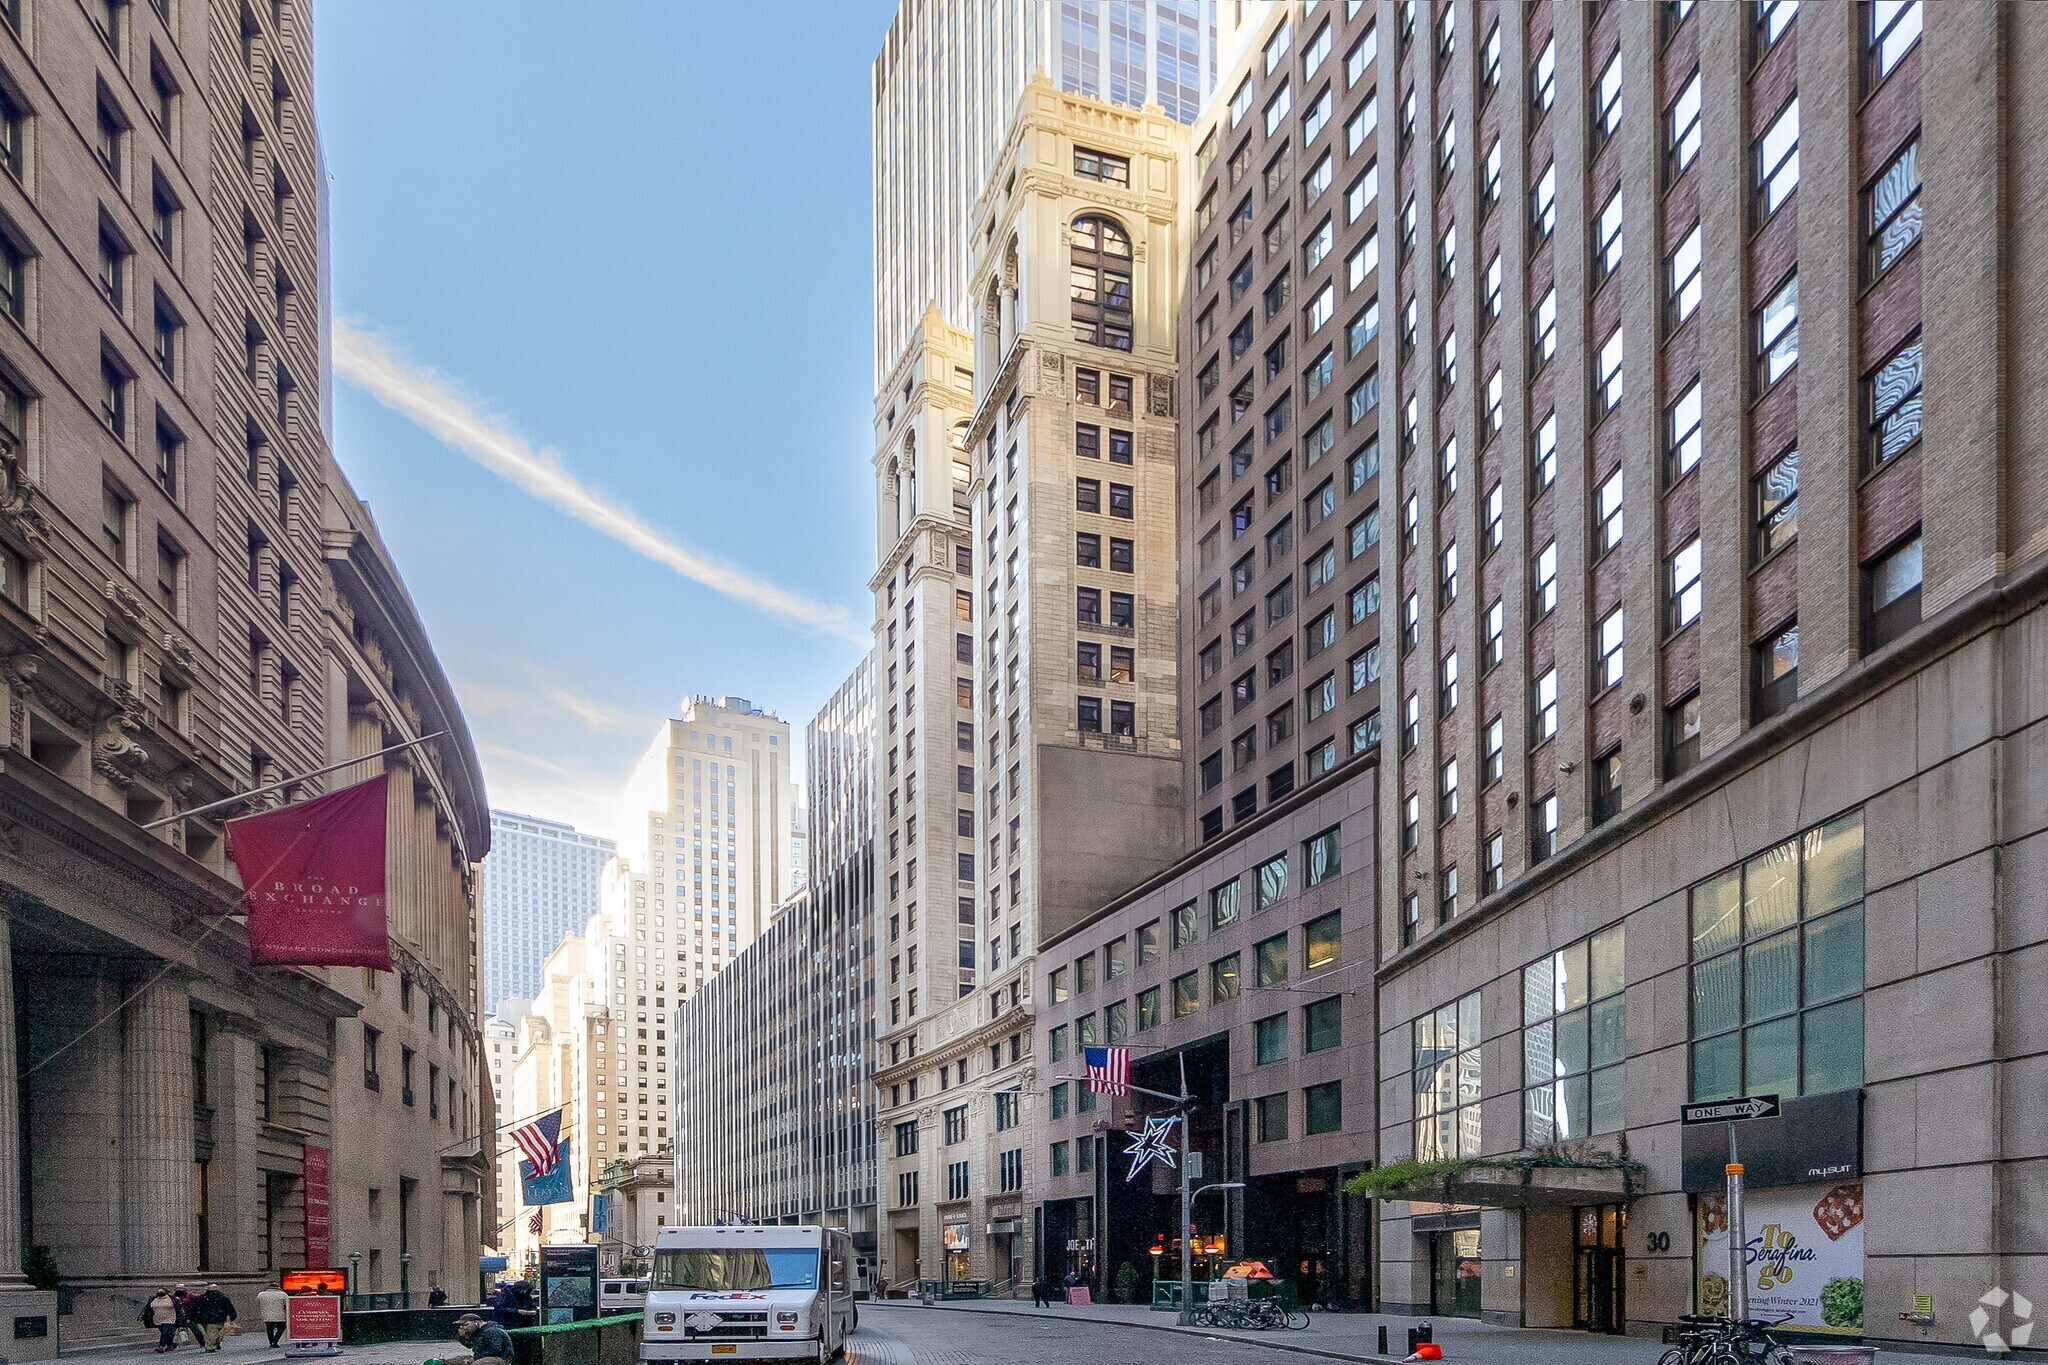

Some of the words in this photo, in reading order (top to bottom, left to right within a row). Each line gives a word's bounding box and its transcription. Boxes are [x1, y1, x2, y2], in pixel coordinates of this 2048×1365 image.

[274, 882, 359, 895] BROAD
[249, 891, 384, 907] EXCHANGE
[1695, 1107, 1722, 1118] ONE
[1735, 1102, 1764, 1114] WAY
[1646, 1231, 1671, 1252] 30
[1760, 1223, 1794, 1249] To
[1066, 1239, 1080, 1251] JOE
[1757, 1261, 1793, 1291] go
[689, 1292, 768, 1301] FedEx
[1770, 1296, 1799, 1306] Winter
[1799, 1297, 1819, 1307] 2021
